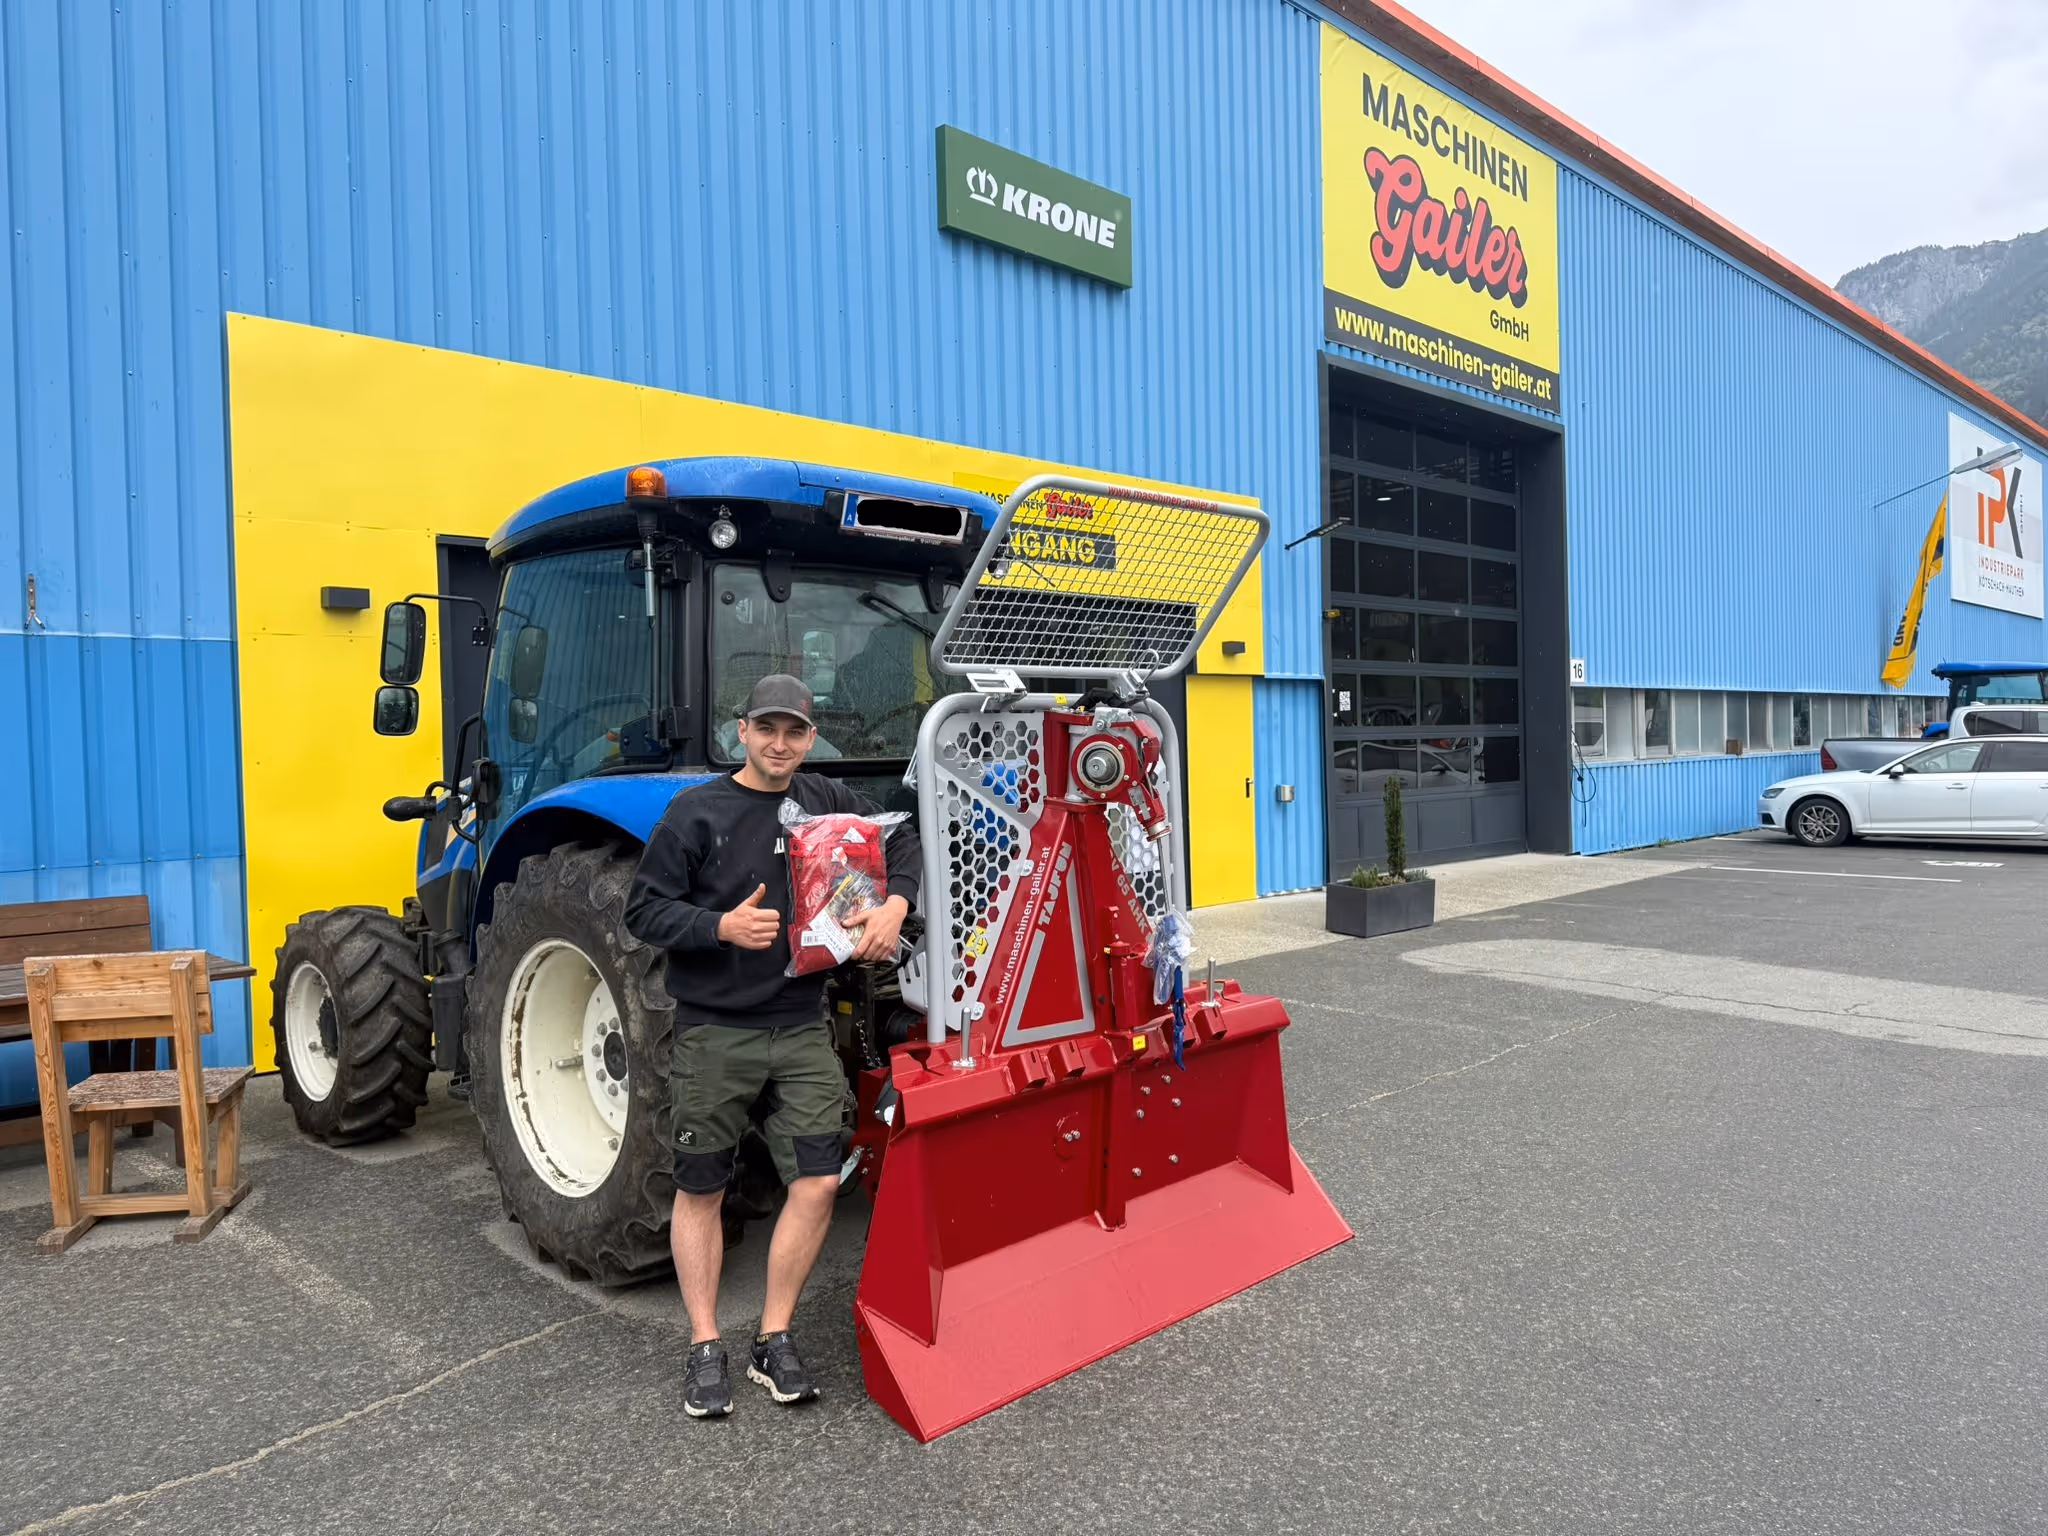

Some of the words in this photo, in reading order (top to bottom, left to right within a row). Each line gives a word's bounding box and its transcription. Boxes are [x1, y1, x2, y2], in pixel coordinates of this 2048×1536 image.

[1363, 72, 1528, 202] MASCHINEN
[1002, 182, 1116, 249] KRONE
[1364, 147, 1528, 308] Gailer
[1334, 306, 1552, 401] www.maschinen-gailer.at
[1490, 309, 1530, 342] GmbH
[1009, 530, 1097, 564] NGANG
[1978, 554, 2025, 580] INDUSTRIEPARK
[1573, 663, 1583, 679] 16
[1038, 841, 1073, 926] TAJFUN
[1117, 874, 1131, 896] 65
[1128, 898, 1149, 934] AHK
[996, 846, 1051, 1005] www.maschinen-gailer.at
